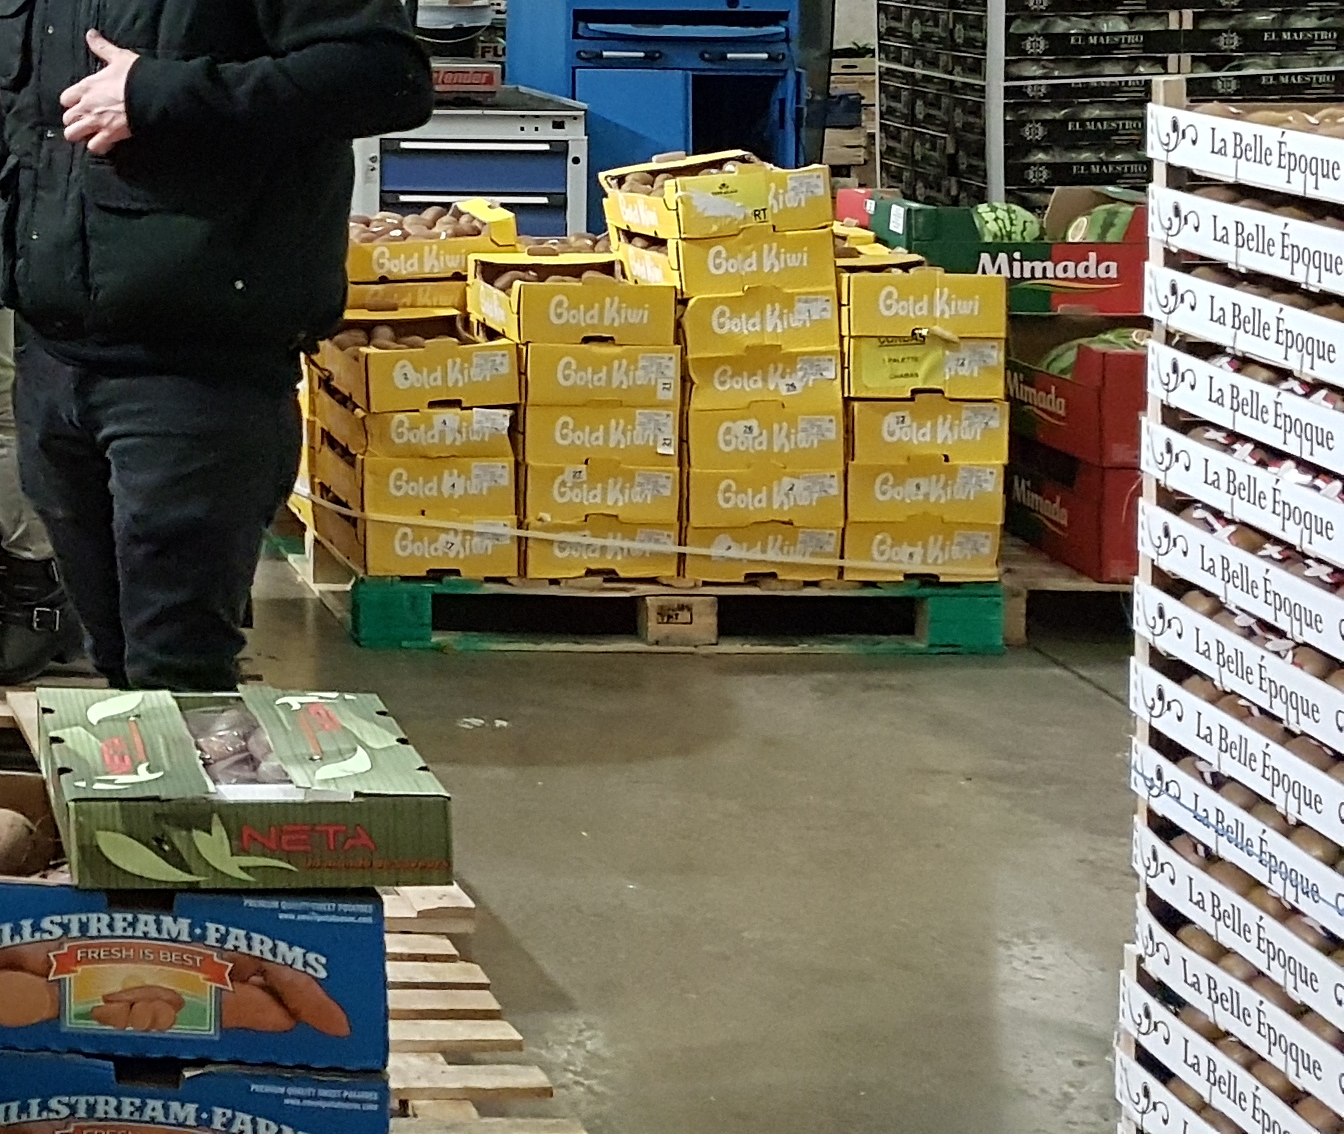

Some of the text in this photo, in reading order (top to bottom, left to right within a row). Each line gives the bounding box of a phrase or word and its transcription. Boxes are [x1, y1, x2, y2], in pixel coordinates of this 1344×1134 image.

[1210, 127, 1340, 190] La Belle Époque
[372, 244, 467, 276] Gold Kiwi
[708, 243, 808, 276] Gold Kiwi
[976, 251, 1118, 280] Mimada
[1212, 215, 1343, 284] La Belle Époque
[549, 294, 649, 327] Gold Kiwi
[878, 286, 979, 318] Gold Kiwi
[1209, 295, 1336, 371] La Belle Époque
[1013, 474, 1068, 527] Mimada
[1203, 458, 1334, 545] La Belle Époque
[1195, 627, 1320, 725] La Belle Époque
[1196, 711, 1323, 815] La Belle Époque
[241, 824, 376, 852] NETA
[76, 948, 204, 966] FRESH IS BEST
[204, 921, 329, 980] FARMS
[1188, 876, 1319, 993] La Belle Époque
